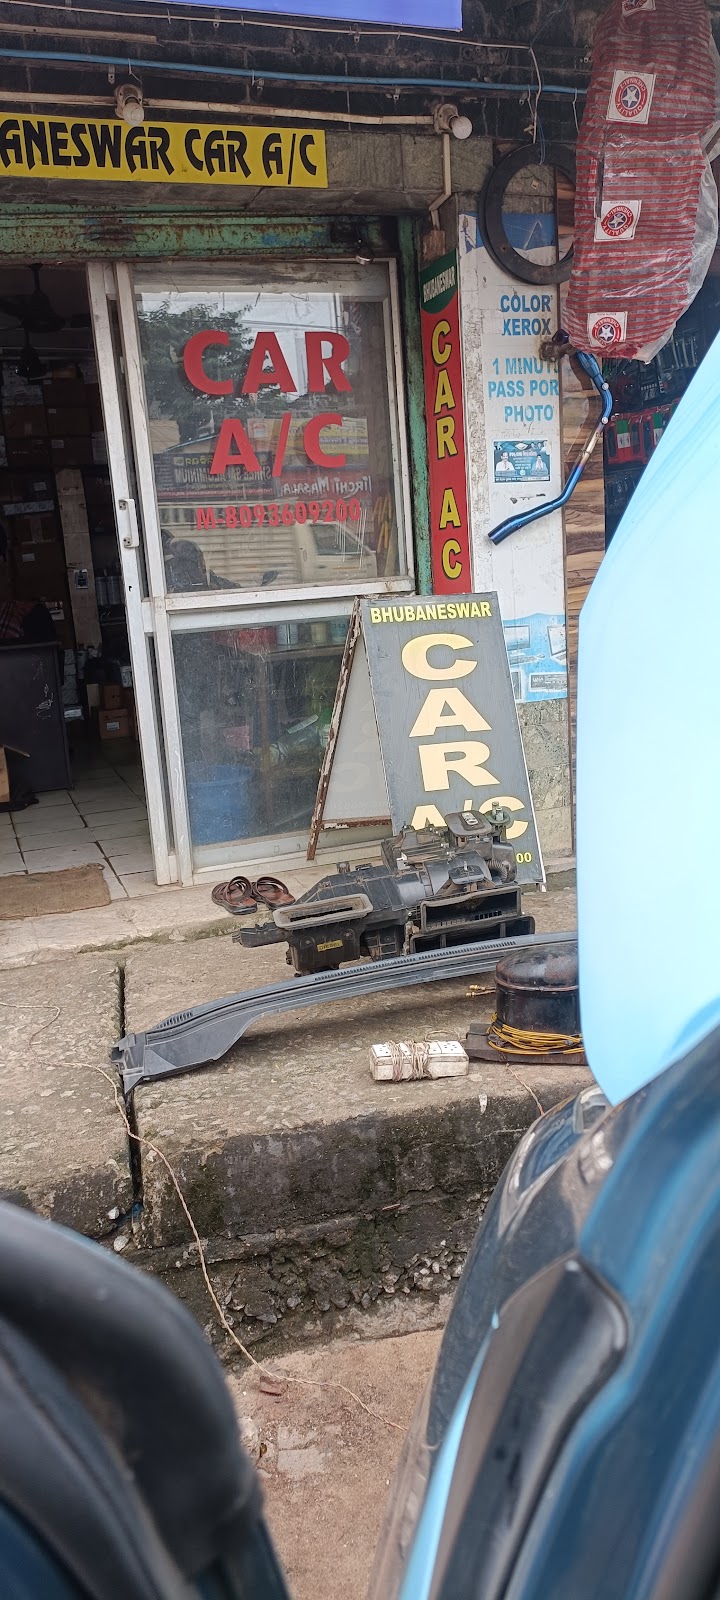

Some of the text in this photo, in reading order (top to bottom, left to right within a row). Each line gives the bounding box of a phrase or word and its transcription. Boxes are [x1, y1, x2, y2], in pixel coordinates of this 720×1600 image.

[616, 102, 643, 116] QUALITY
[184, 128, 251, 178] CAR
[261, 132, 317, 185] A/C
[602, 224, 629, 236] QUALITY
[423, 266, 456, 303] BHUBANESWAR
[500, 294, 551, 312] COLOR
[501, 318, 551, 336] XEROX
[182, 330, 353, 396] CAR
[492, 357, 499, 375] 1
[488, 380, 525, 398] PASS
[504, 404, 554, 423] PHOTO
[209, 412, 347, 477] A/C
[432, 320, 462, 579] CAR AC
[196, 498, 361, 530] M-8093609200
[370, 601, 492, 624] BHUBANESWAR
[401, 633, 500, 792] CAR
